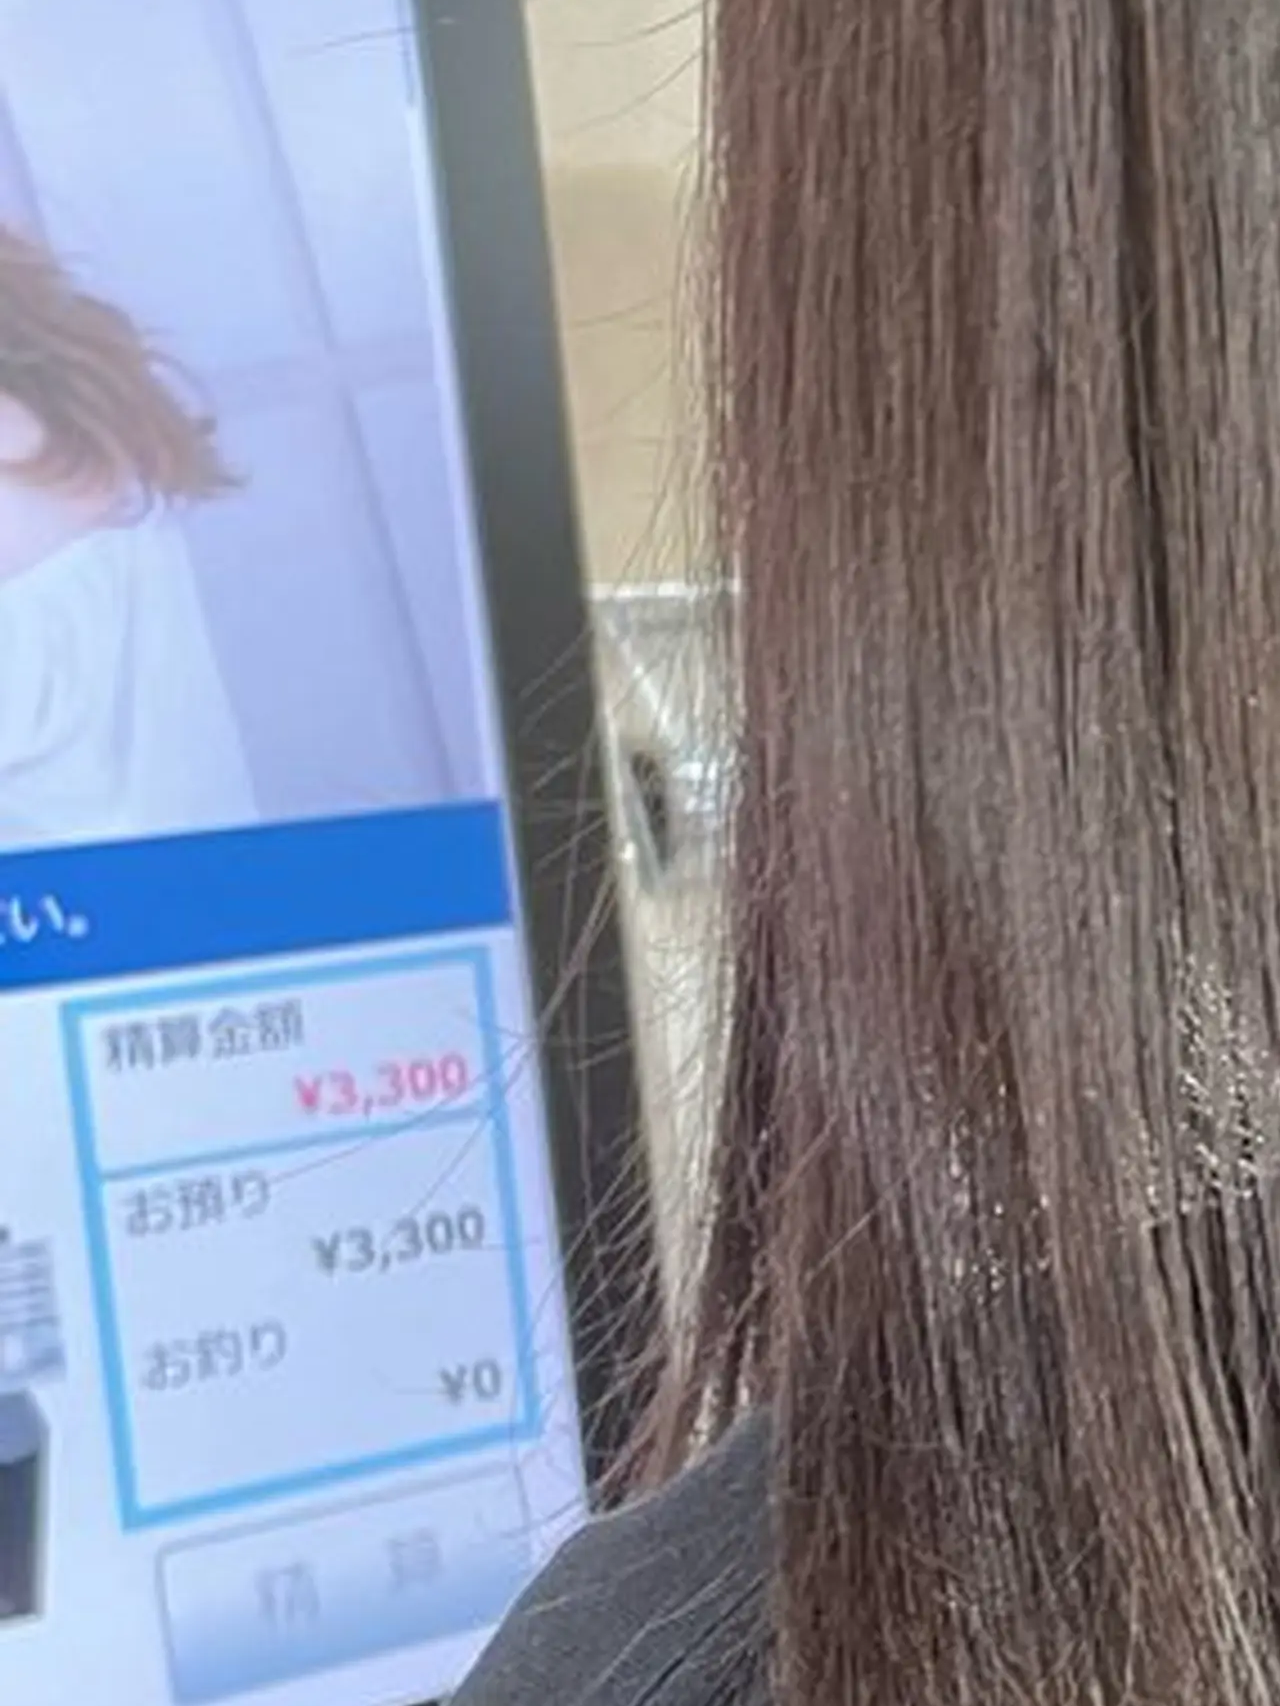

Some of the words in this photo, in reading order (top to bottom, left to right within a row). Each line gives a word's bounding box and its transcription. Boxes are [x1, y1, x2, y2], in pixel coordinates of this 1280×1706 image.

[0, 893, 89, 944] い。
[103, 1000, 306, 1071] 精算金額
[293, 1051, 471, 1121] ¥3,300
[122, 1170, 272, 1237] お預り
[311, 1205, 485, 1276] ¥3,300
[143, 1320, 288, 1391] お釣り
[439, 1357, 502, 1404] ¥0
